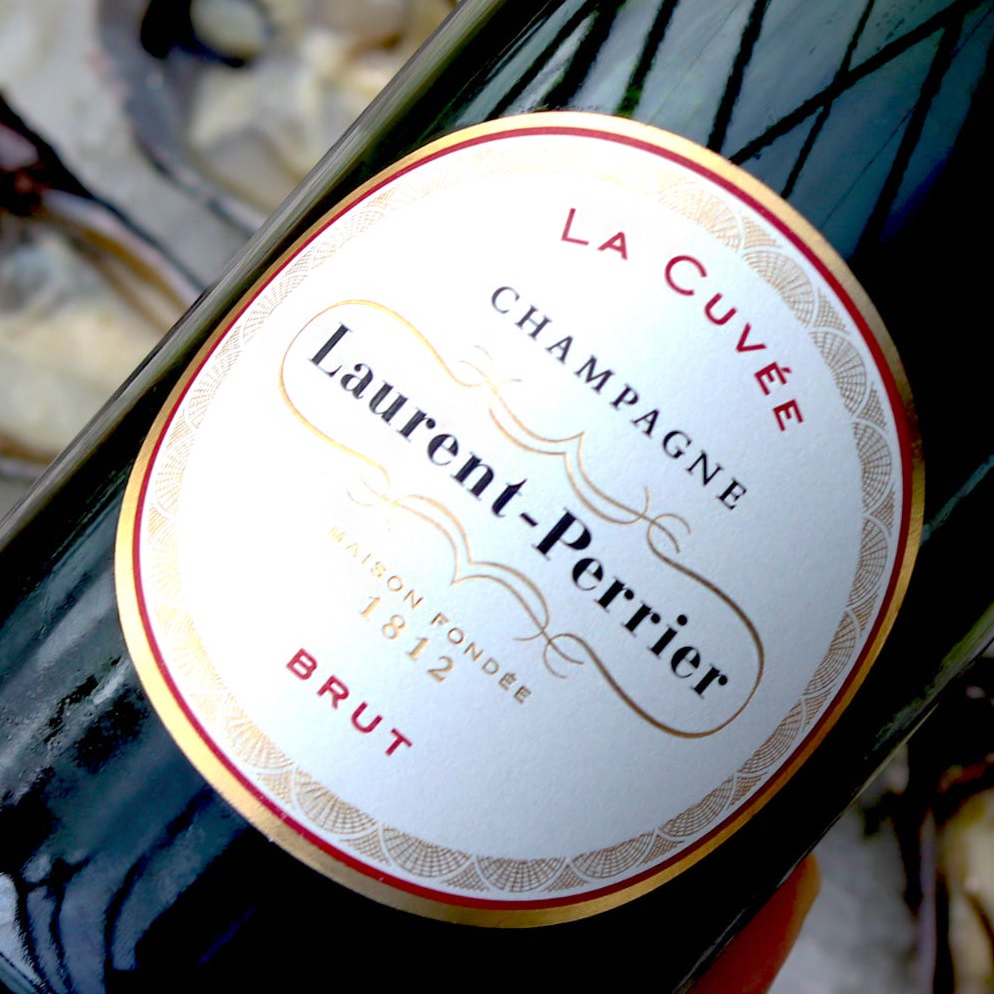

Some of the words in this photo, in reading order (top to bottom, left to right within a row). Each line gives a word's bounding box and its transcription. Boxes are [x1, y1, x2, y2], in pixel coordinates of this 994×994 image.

[560, 207, 629, 261] LA
[488, 285, 747, 511] CHAMPAGNE
[307, 322, 730, 699] Laurent-Perrier
[328, 524, 424, 611] MAISON
[430, 611, 535, 707] FONDÉE
[357, 594, 455, 684] 1812
[285, 647, 412, 758] BRUT
